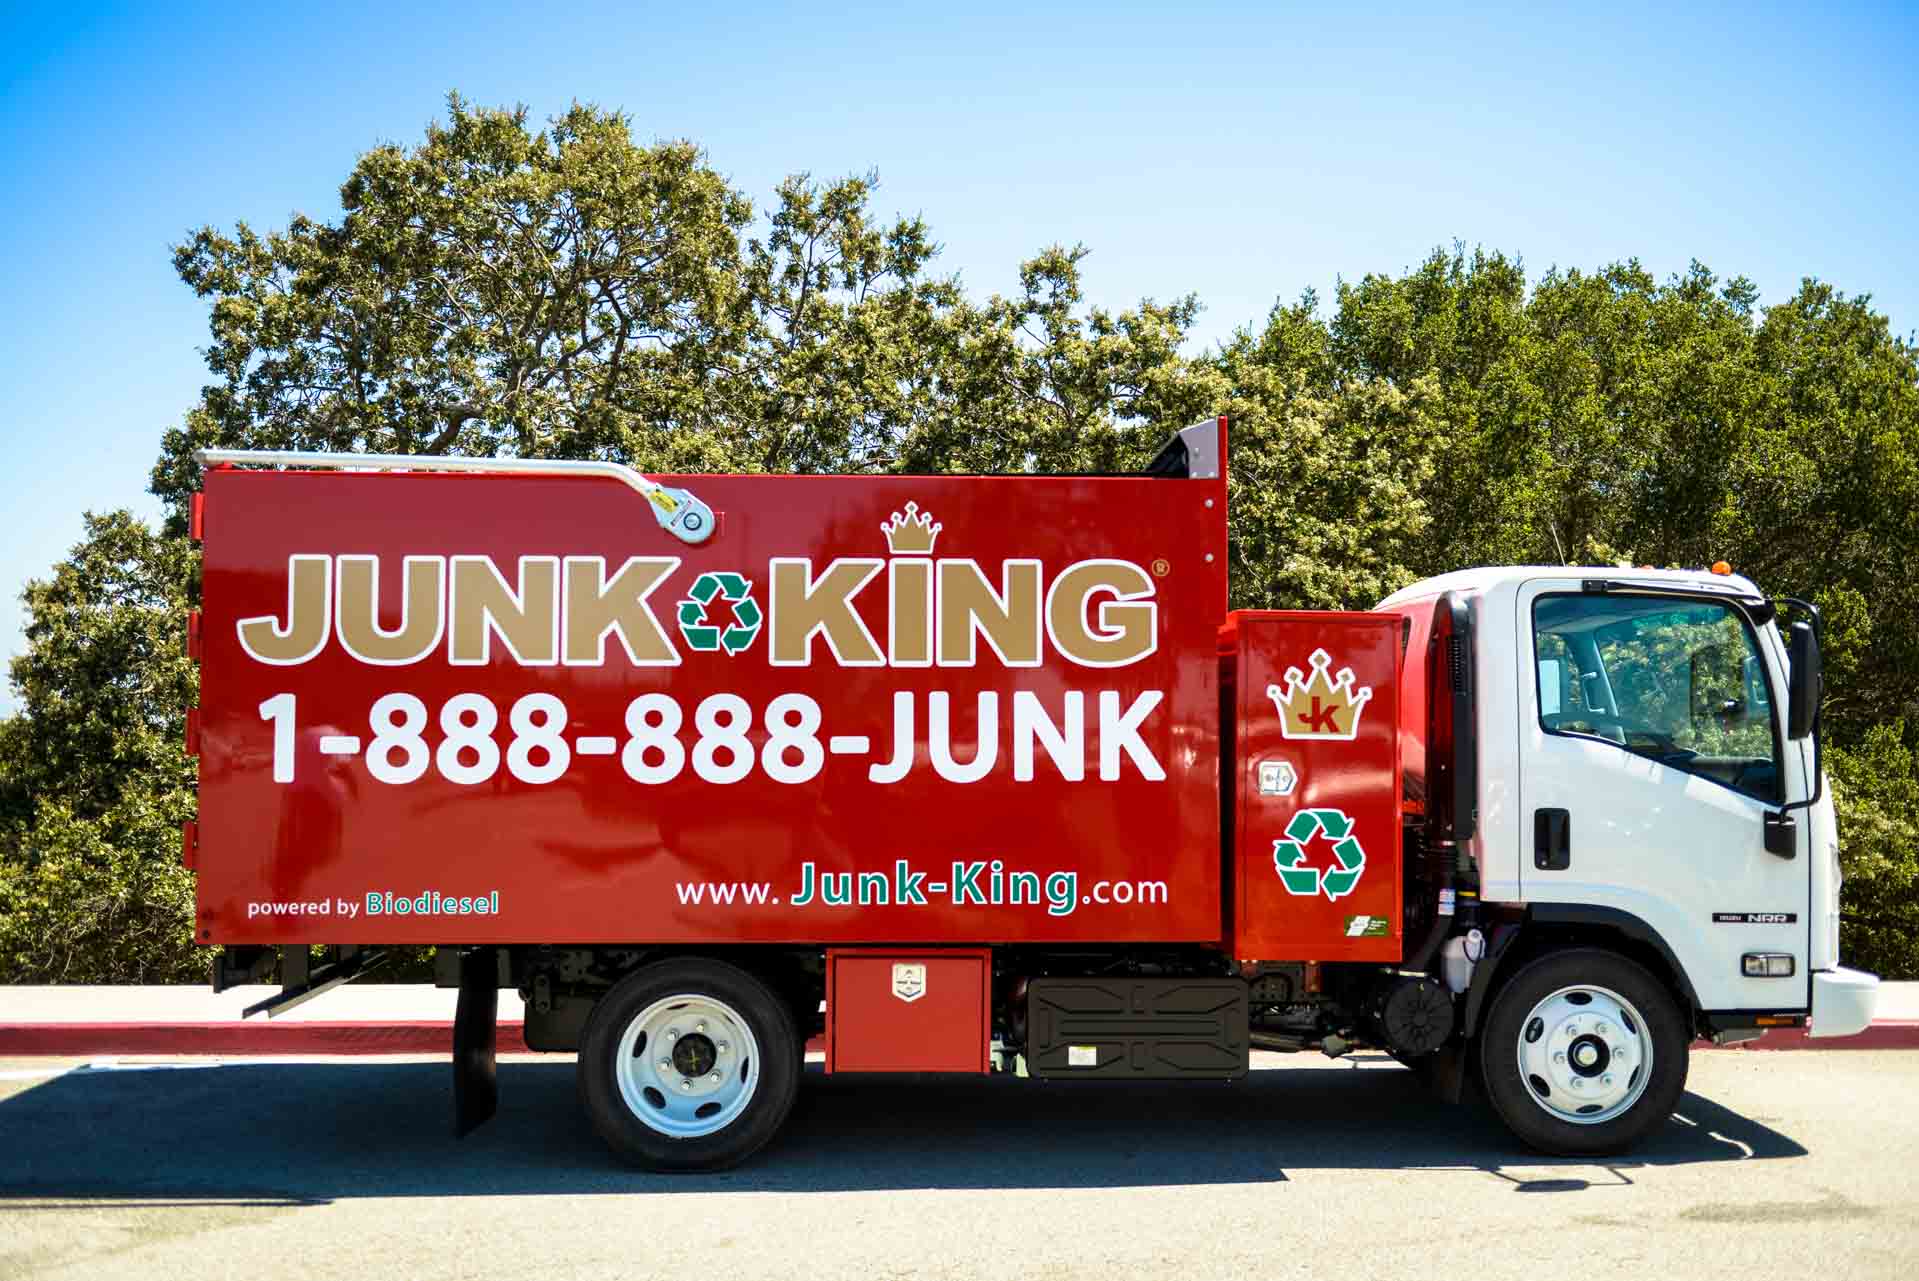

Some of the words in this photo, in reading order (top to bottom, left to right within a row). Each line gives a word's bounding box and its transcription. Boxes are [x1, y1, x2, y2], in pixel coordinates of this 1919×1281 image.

[236, 554, 681, 667] JUNK
[259, 691, 1166, 784] 1-888-888-JUNK
[248, 898, 330, 918] powered
[337, 898, 360, 918] by
[366, 891, 499, 915] Biodiesel
